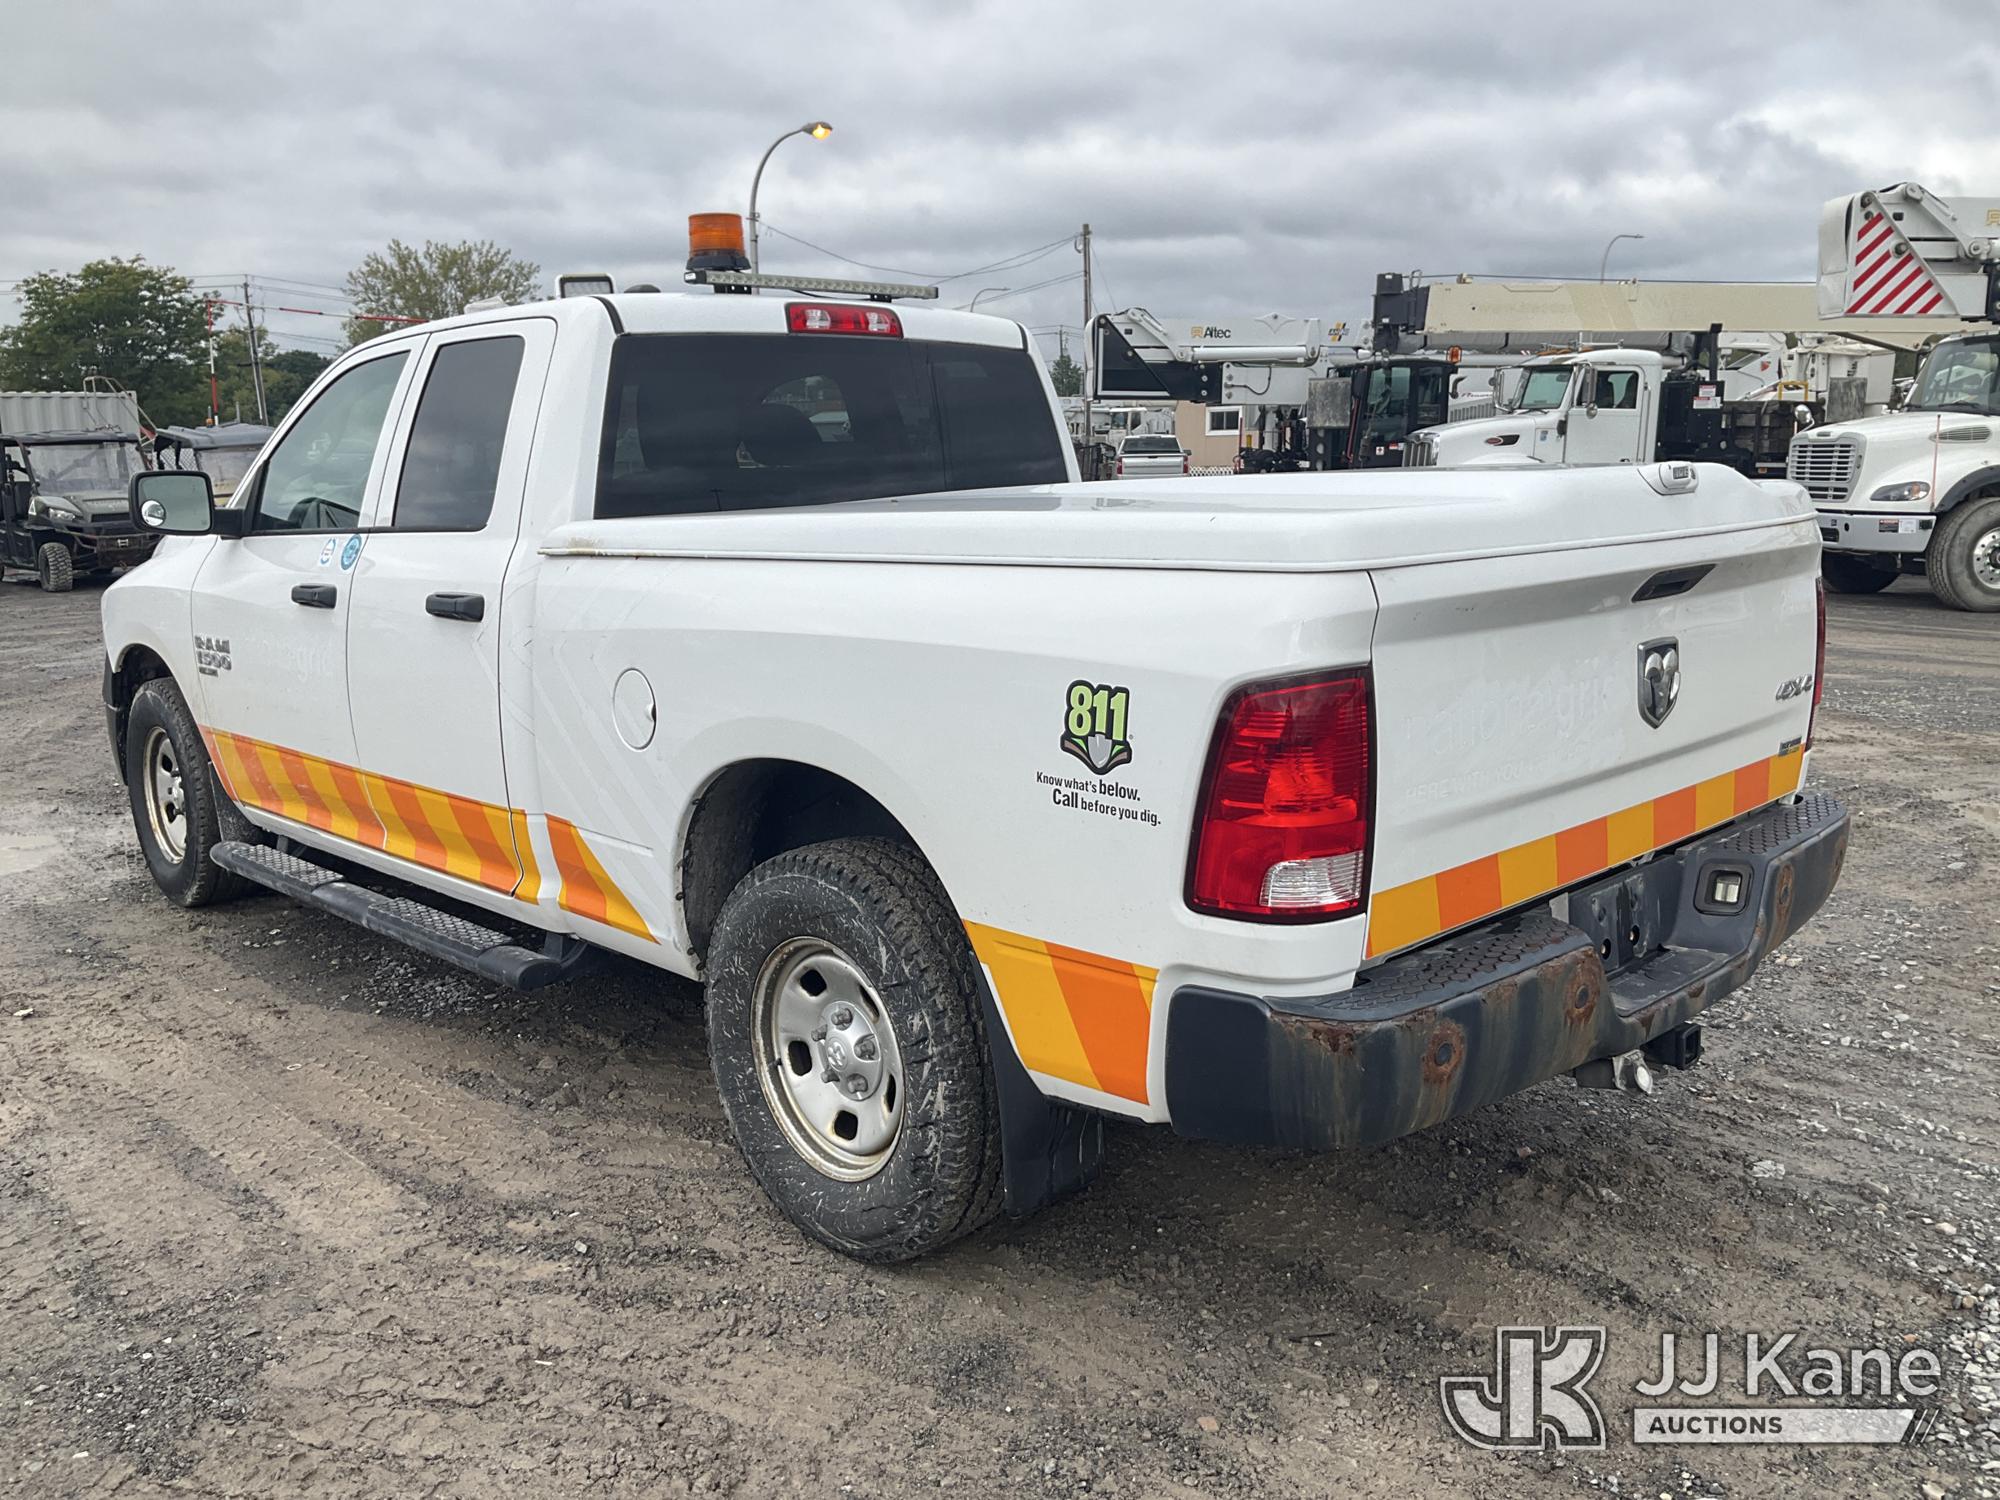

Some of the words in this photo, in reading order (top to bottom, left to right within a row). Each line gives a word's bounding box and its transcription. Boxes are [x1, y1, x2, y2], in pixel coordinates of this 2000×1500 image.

[1203, 326, 1231, 339] Altec
[194, 634, 231, 654] RAM
[197, 650, 232, 671] 1500
[1067, 683, 1128, 742] 811
[1036, 771, 1063, 787] Know
[1064, 778, 1097, 794] what's
[1099, 779, 1141, 801] below.
[1052, 788, 1078, 809] Call
[1080, 797, 1117, 816] before
[1118, 808, 1138, 820] you
[1140, 809, 1161, 827] dig.
